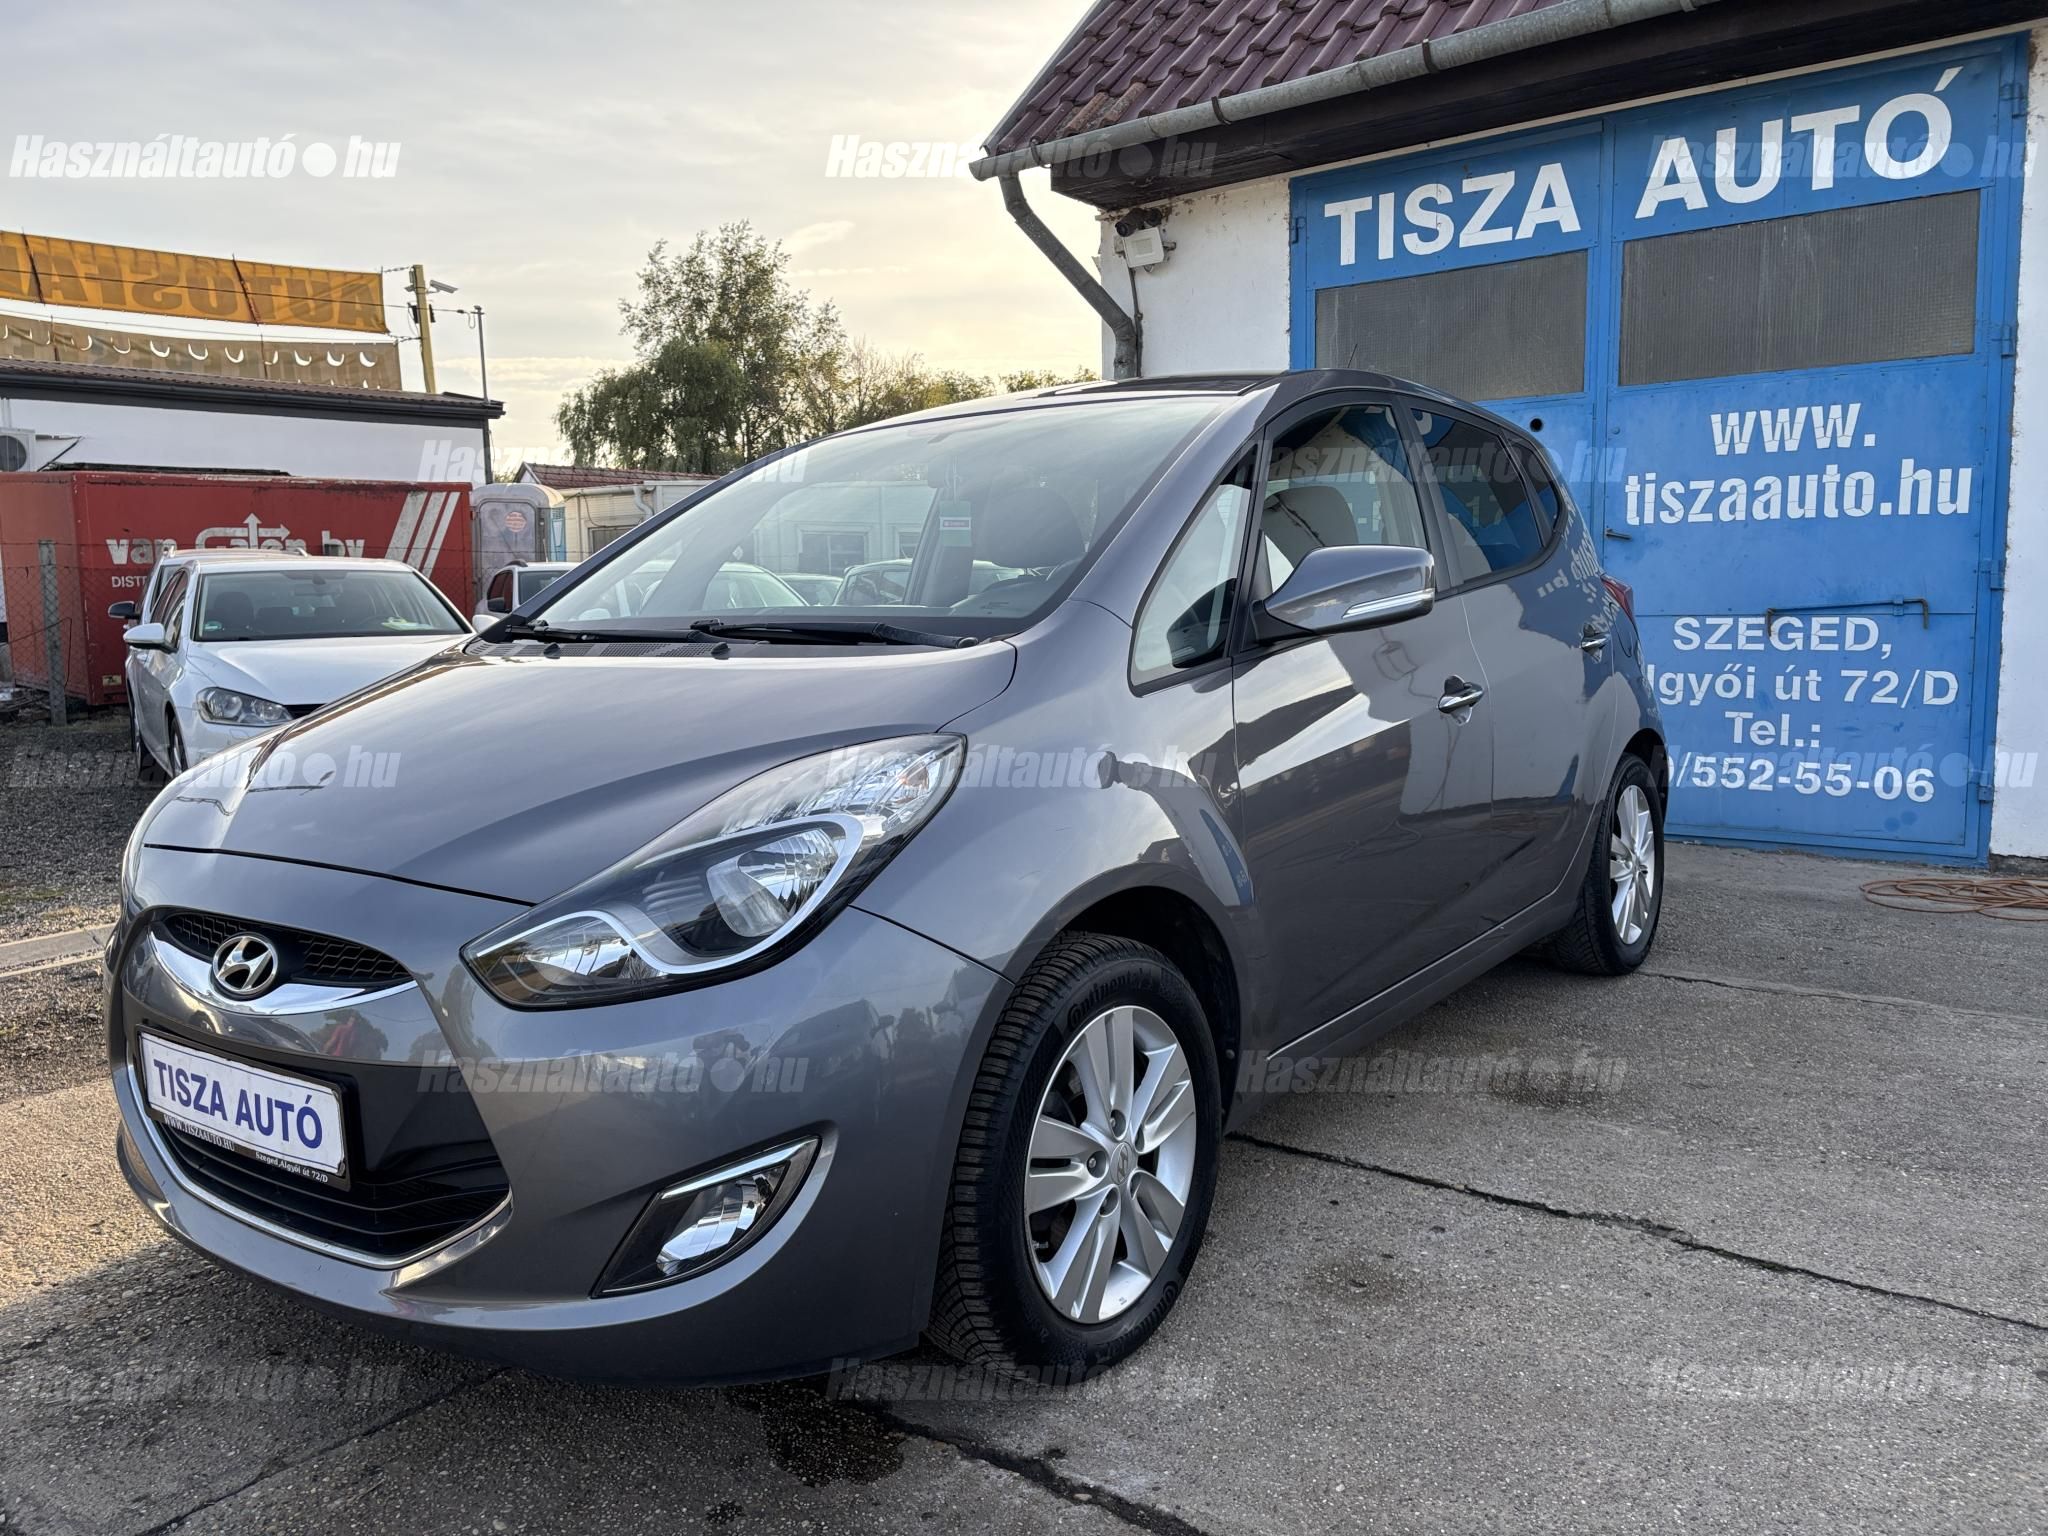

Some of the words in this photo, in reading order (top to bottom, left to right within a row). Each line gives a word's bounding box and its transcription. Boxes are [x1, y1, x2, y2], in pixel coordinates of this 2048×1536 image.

[1324, 161, 1582, 266] TISZA
[1634, 66, 1964, 220] AUTÓ
[1710, 402, 1877, 456] www.
[1625, 458, 1972, 526] tiszaauto.hu
[111, 575, 148, 588] DIST
[1672, 615, 1892, 660] SZEGED,
[1646, 662, 1756, 706] lgyői
[1774, 664, 1823, 703] út
[1840, 669, 1960, 709] 72/D
[1724, 711, 1822, 748] Tel.:
[153, 1058, 228, 1122] TISZA
[235, 1088, 323, 1149] AUTÓ
[163, 1113, 235, 1152] WWW.TISZAAUTO.HU
